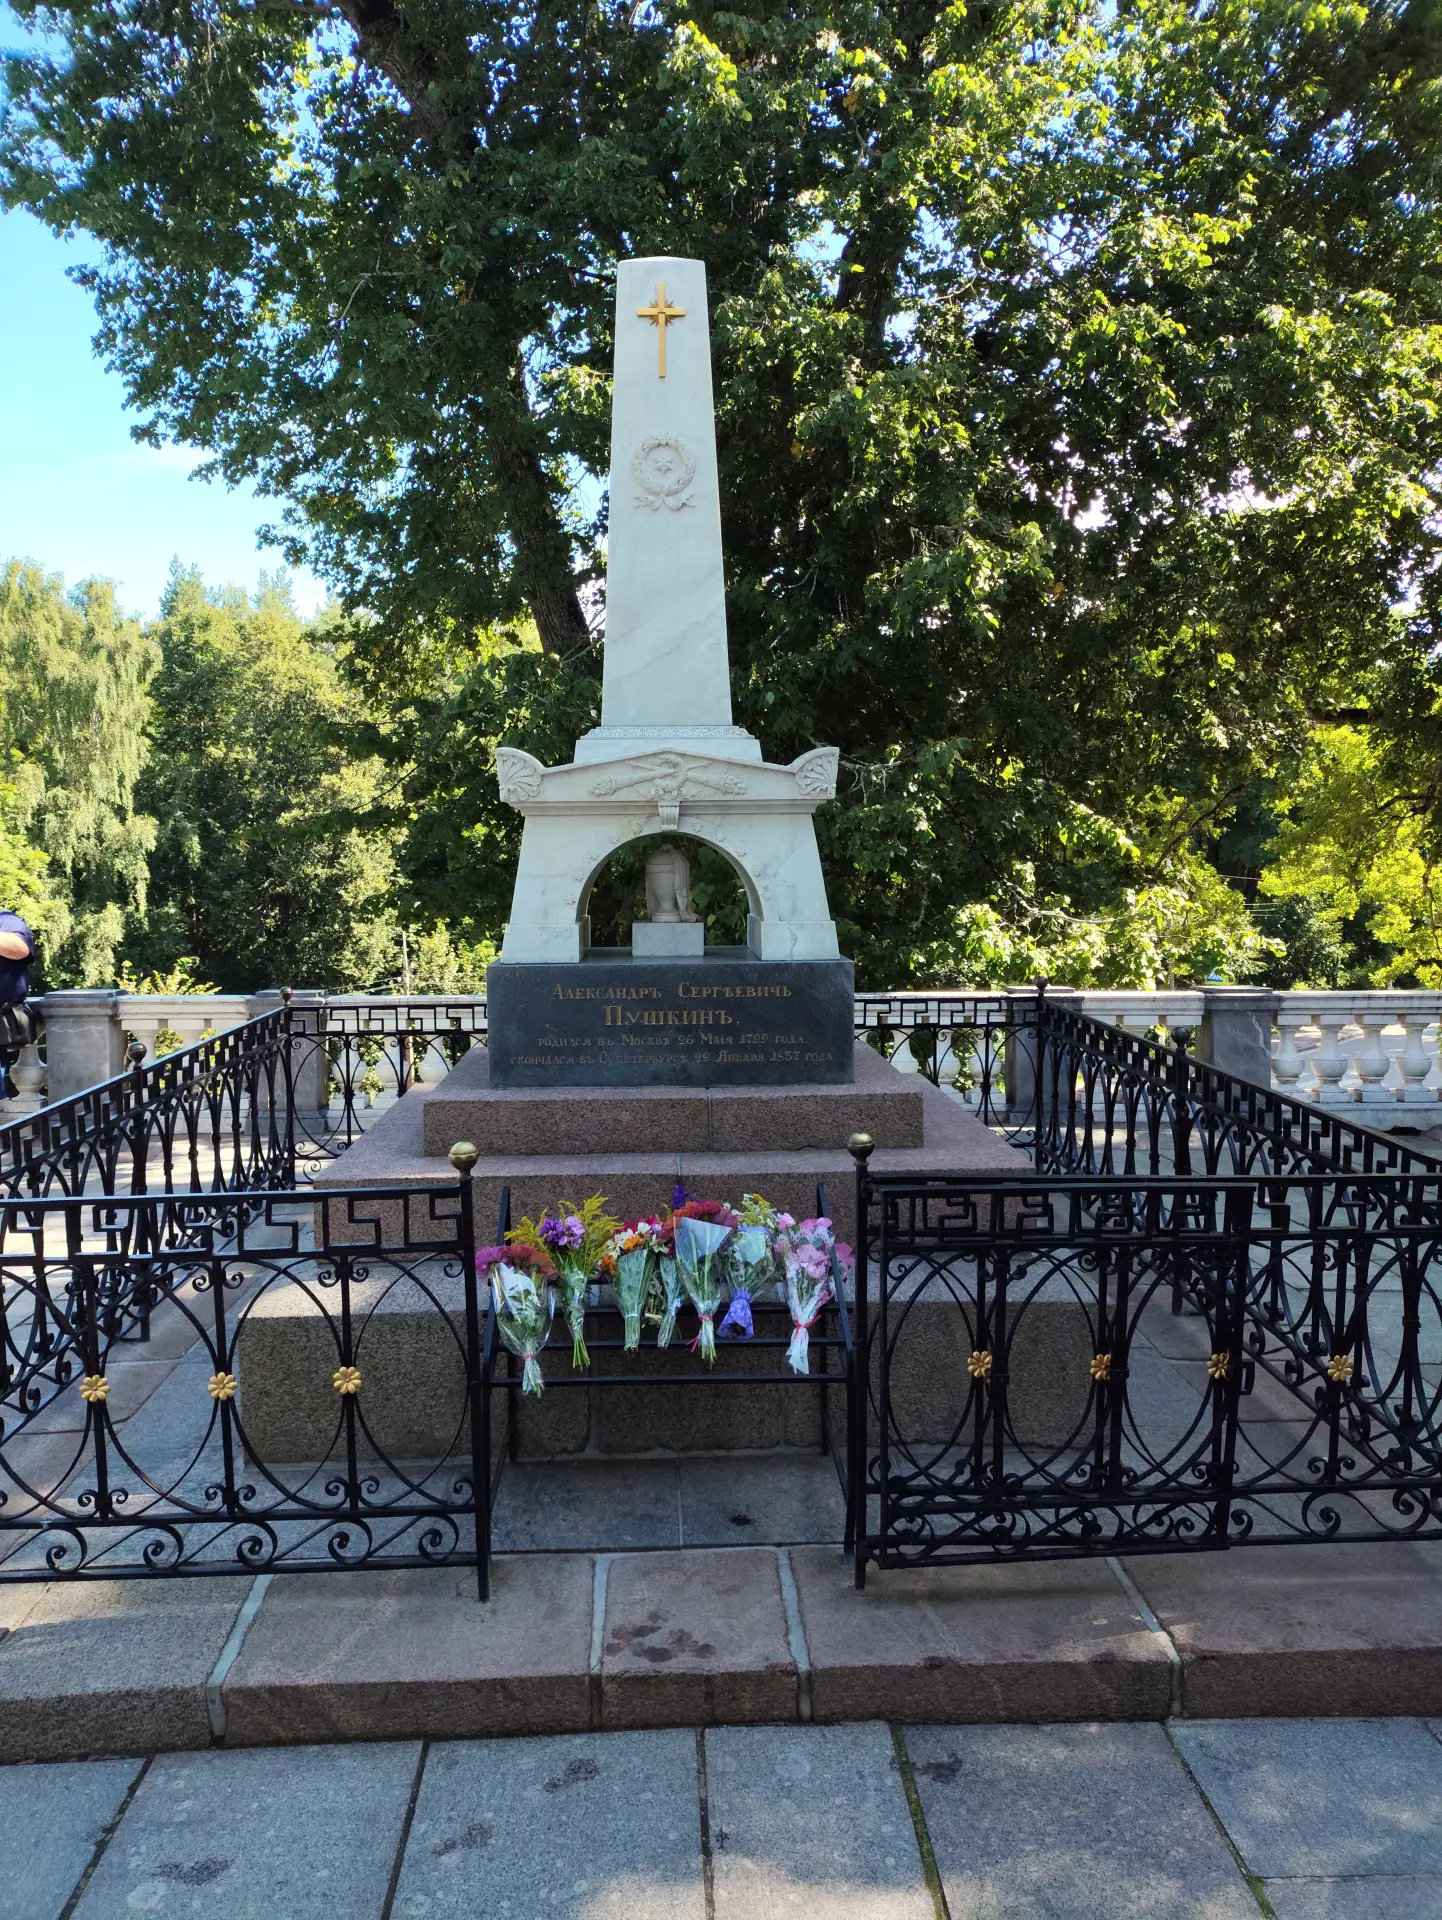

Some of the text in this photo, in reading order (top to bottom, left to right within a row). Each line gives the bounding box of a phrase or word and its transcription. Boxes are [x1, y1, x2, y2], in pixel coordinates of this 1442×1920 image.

[677, 1033, 694, 1045] 26
[738, 1033, 769, 1045] 1799
[694, 1051, 711, 1063] 29
[769, 1050, 801, 1062] 1837
